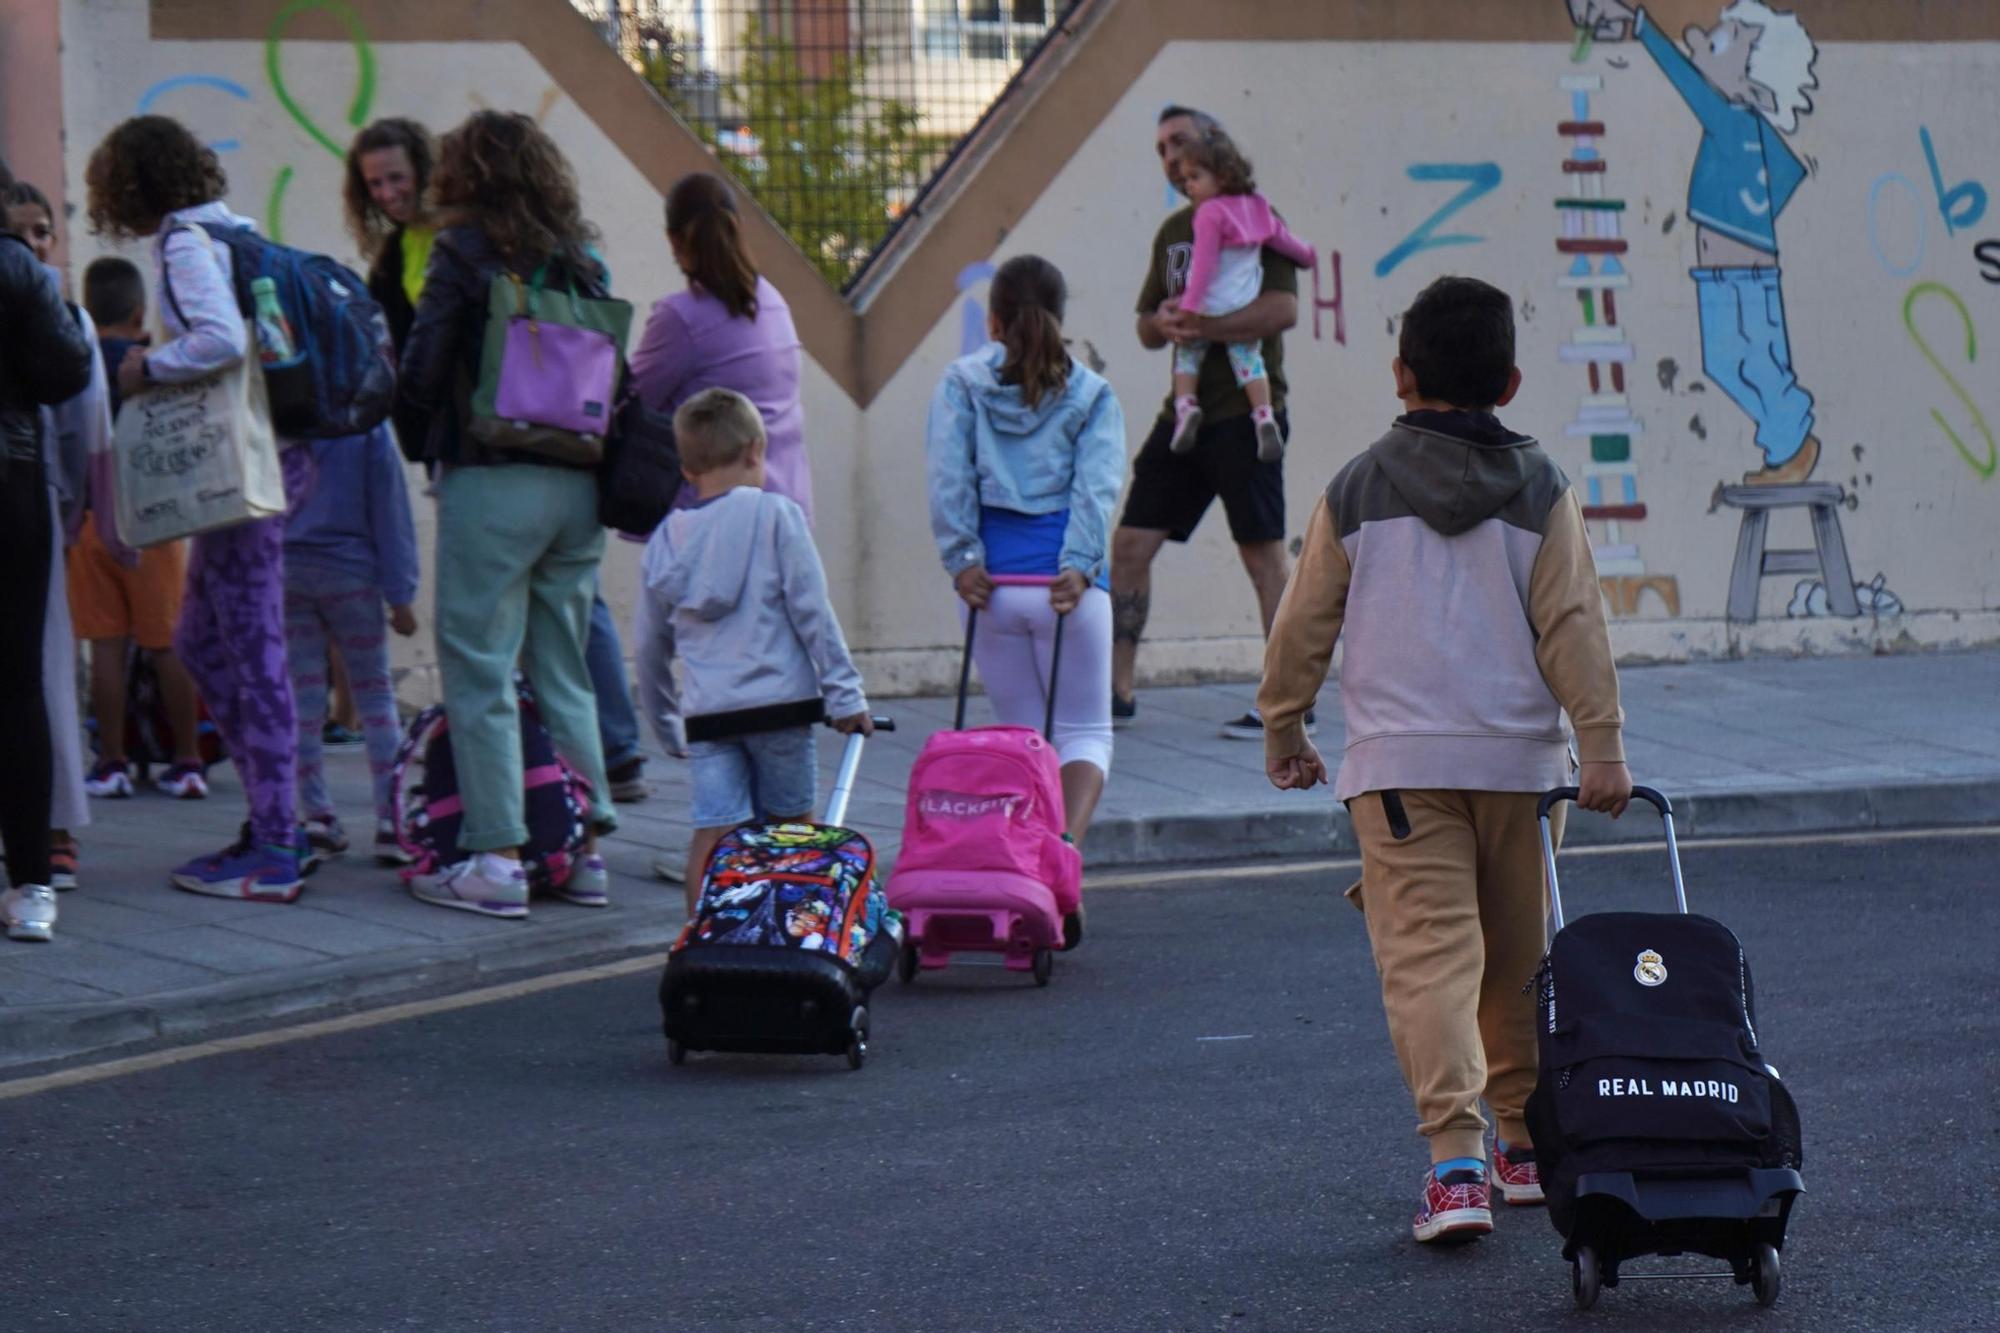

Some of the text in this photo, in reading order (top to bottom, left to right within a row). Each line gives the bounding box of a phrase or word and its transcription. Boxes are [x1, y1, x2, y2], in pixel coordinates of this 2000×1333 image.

[1374, 161, 1503, 278] Z
[1312, 248, 1347, 345] H
[1598, 1078, 1738, 1103] REAL MADRID
